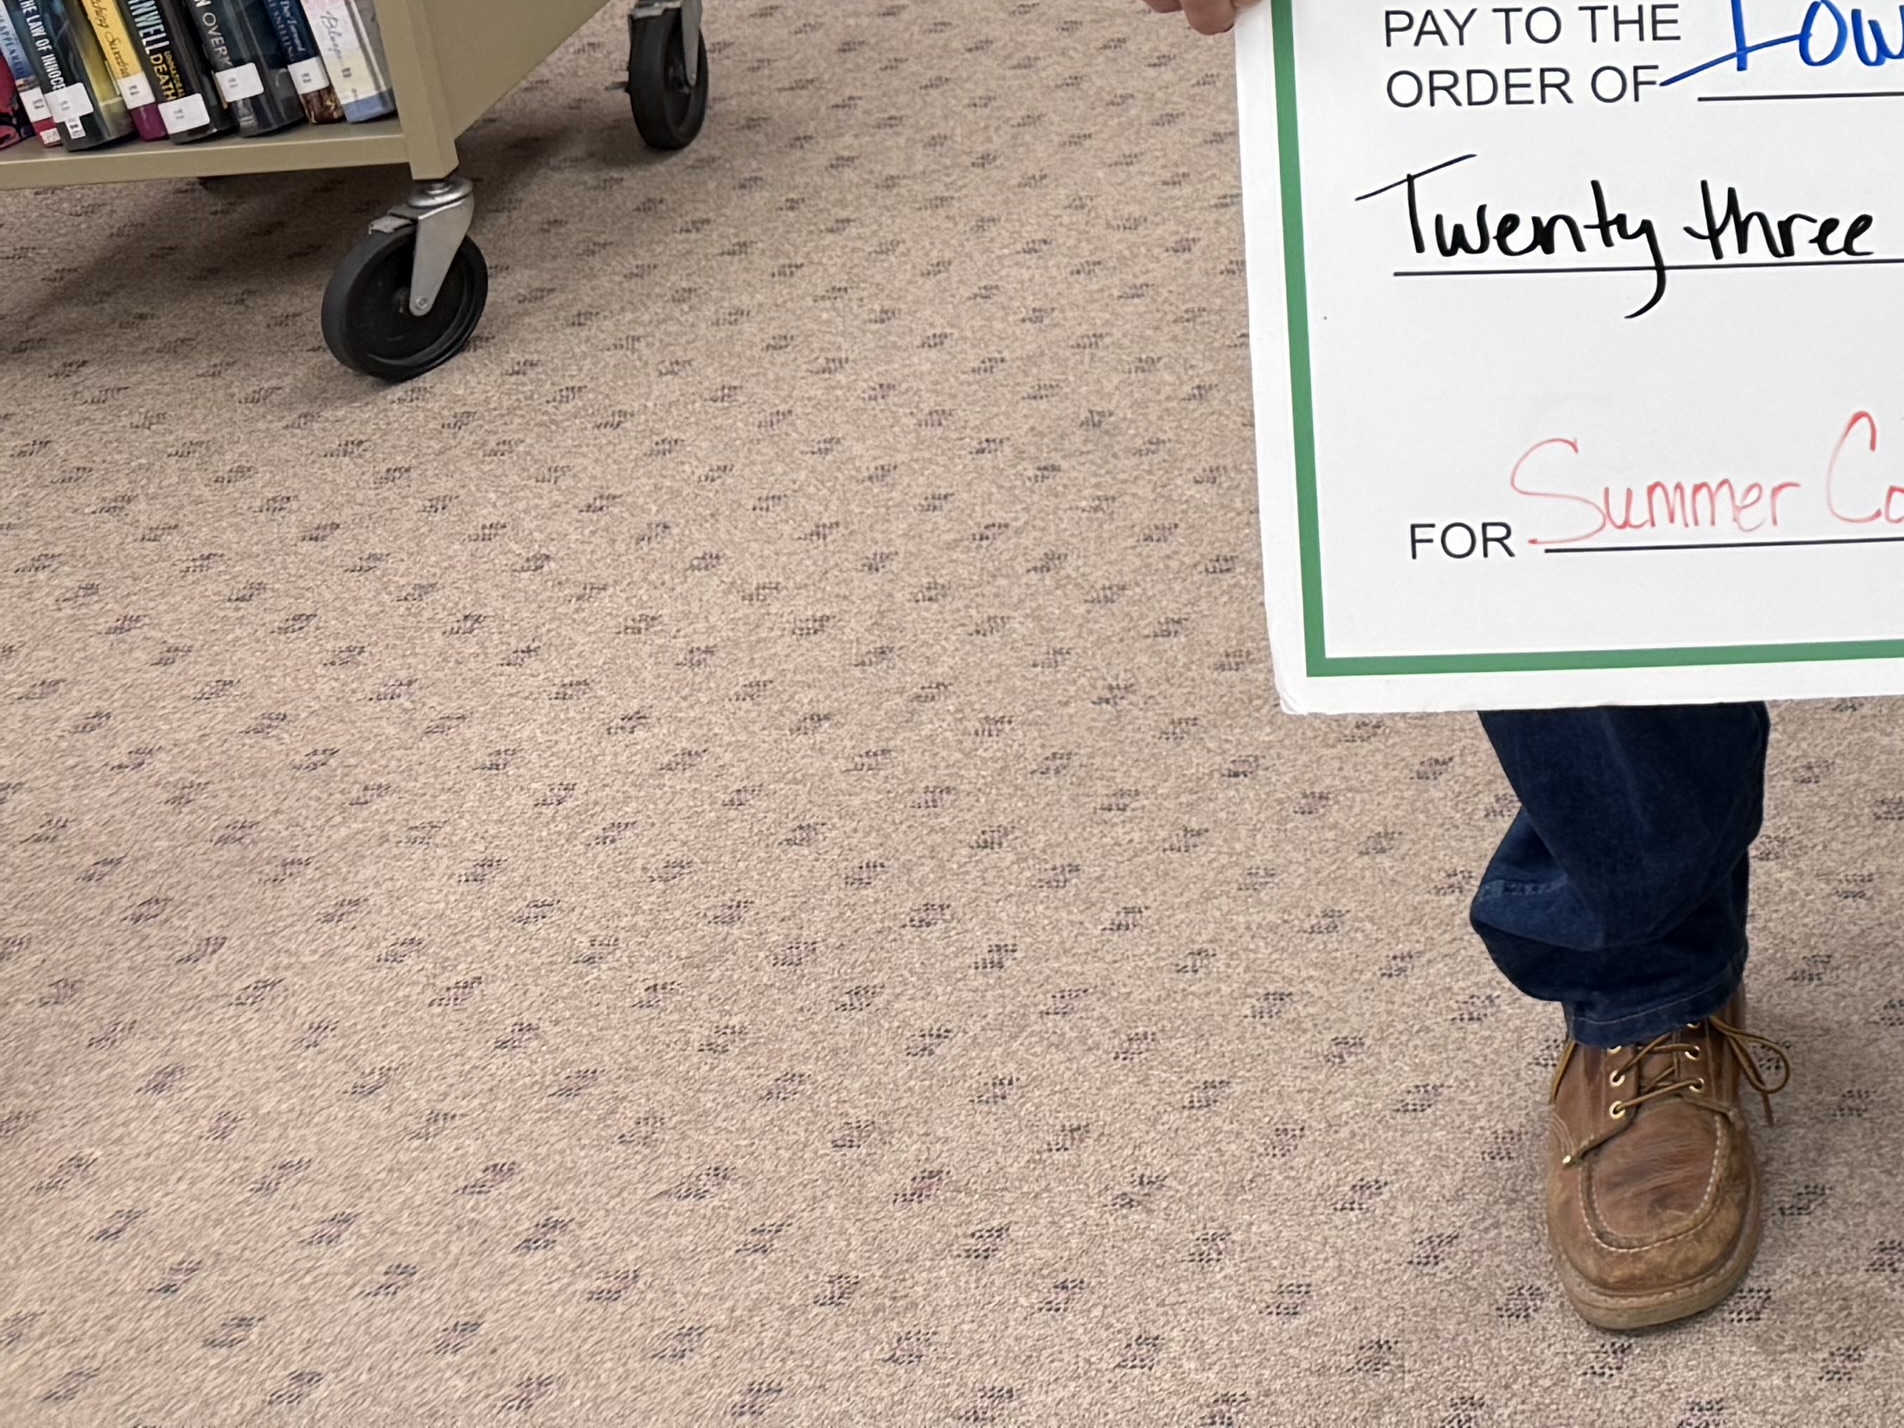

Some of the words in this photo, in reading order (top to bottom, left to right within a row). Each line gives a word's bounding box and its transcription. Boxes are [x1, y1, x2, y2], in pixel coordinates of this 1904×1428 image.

[1382, 6, 1482, 50] PAY
[1497, 5, 1562, 48] TO
[1576, 2, 1682, 45] THE
[1385, 67, 1575, 110] ORDER
[1589, 64, 1660, 106] OF
[1355, 152, 1665, 320] Twenty
[1683, 176, 1875, 262] three
[1509, 436, 1802, 545] Summer
[1408, 520, 1517, 561] FOR
